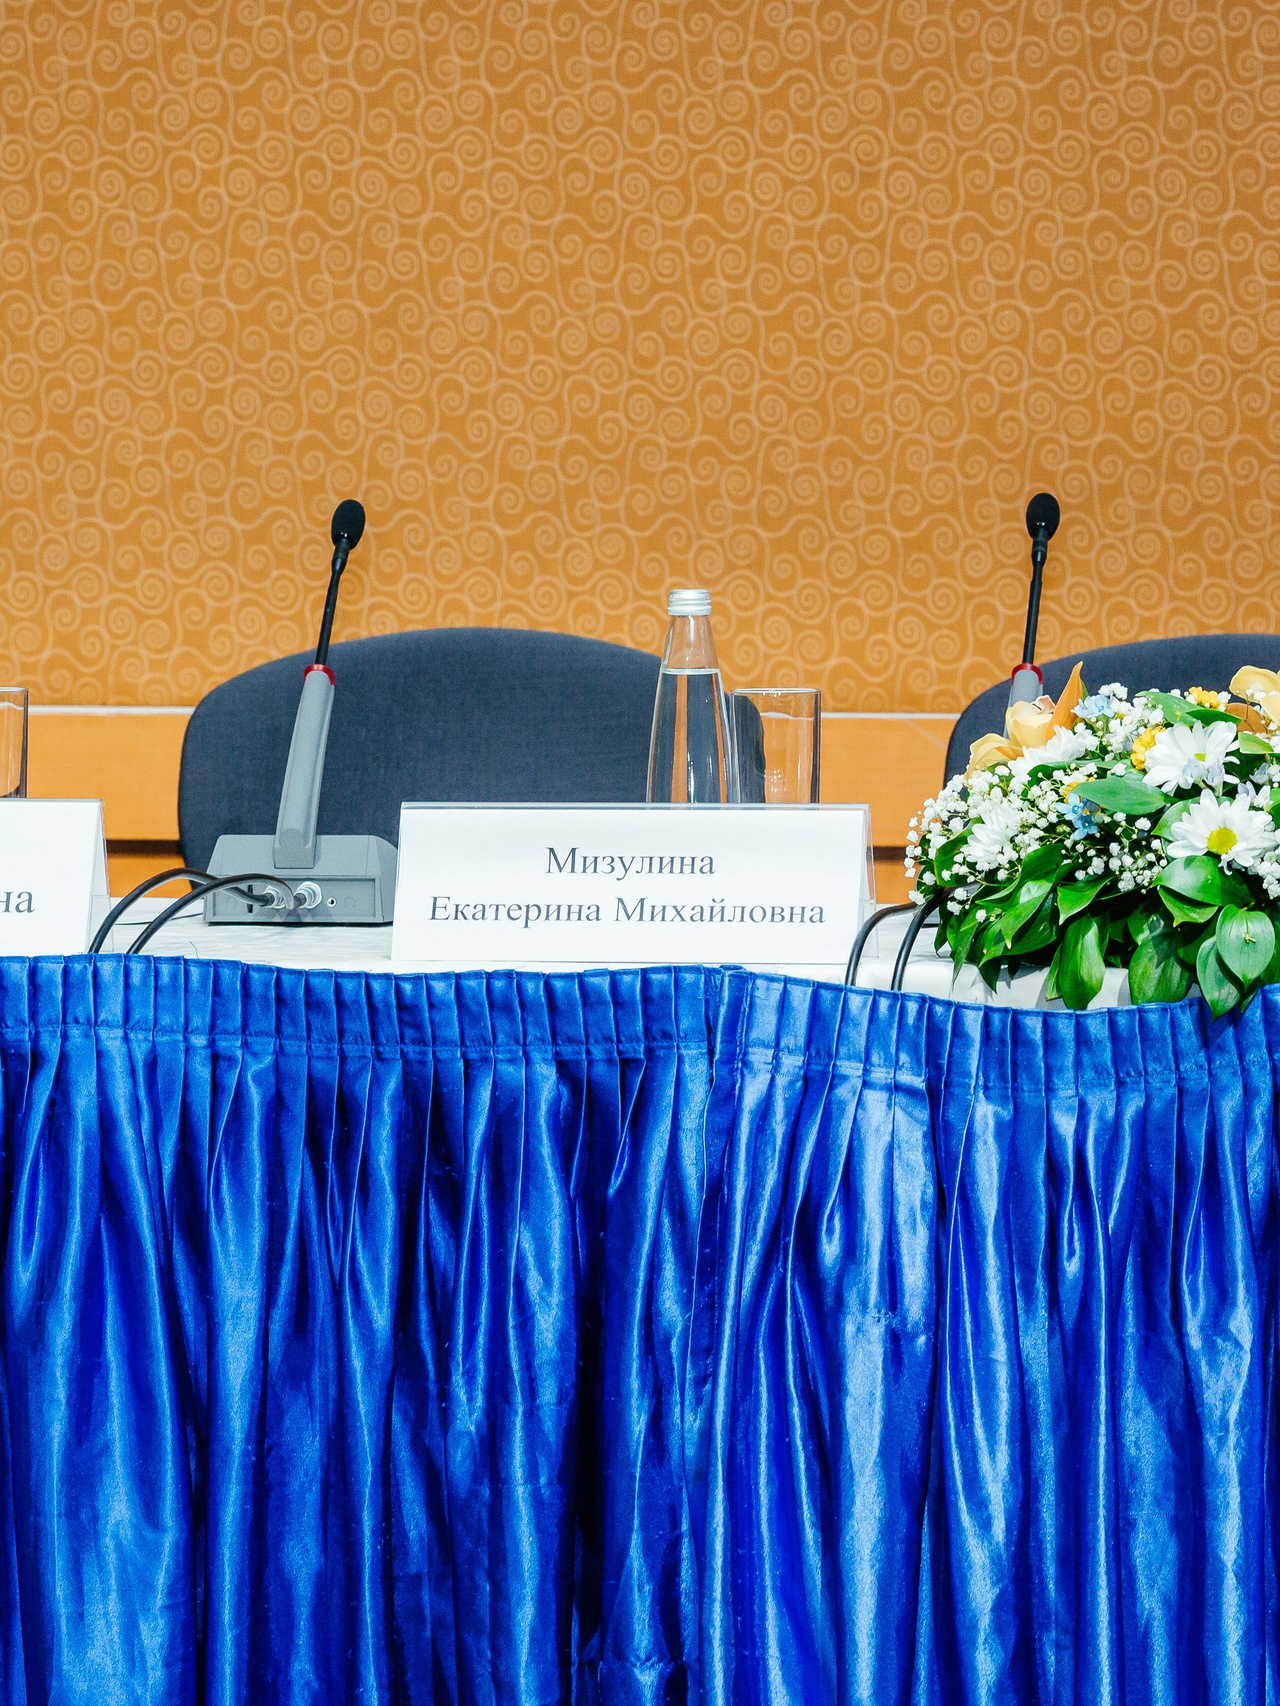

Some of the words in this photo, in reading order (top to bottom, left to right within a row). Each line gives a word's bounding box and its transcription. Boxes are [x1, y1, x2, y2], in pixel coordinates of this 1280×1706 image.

[544, 846, 717, 882] Мизулина
[427, 895, 602, 930] Екатерина
[613, 896, 827, 925] Михайловна
